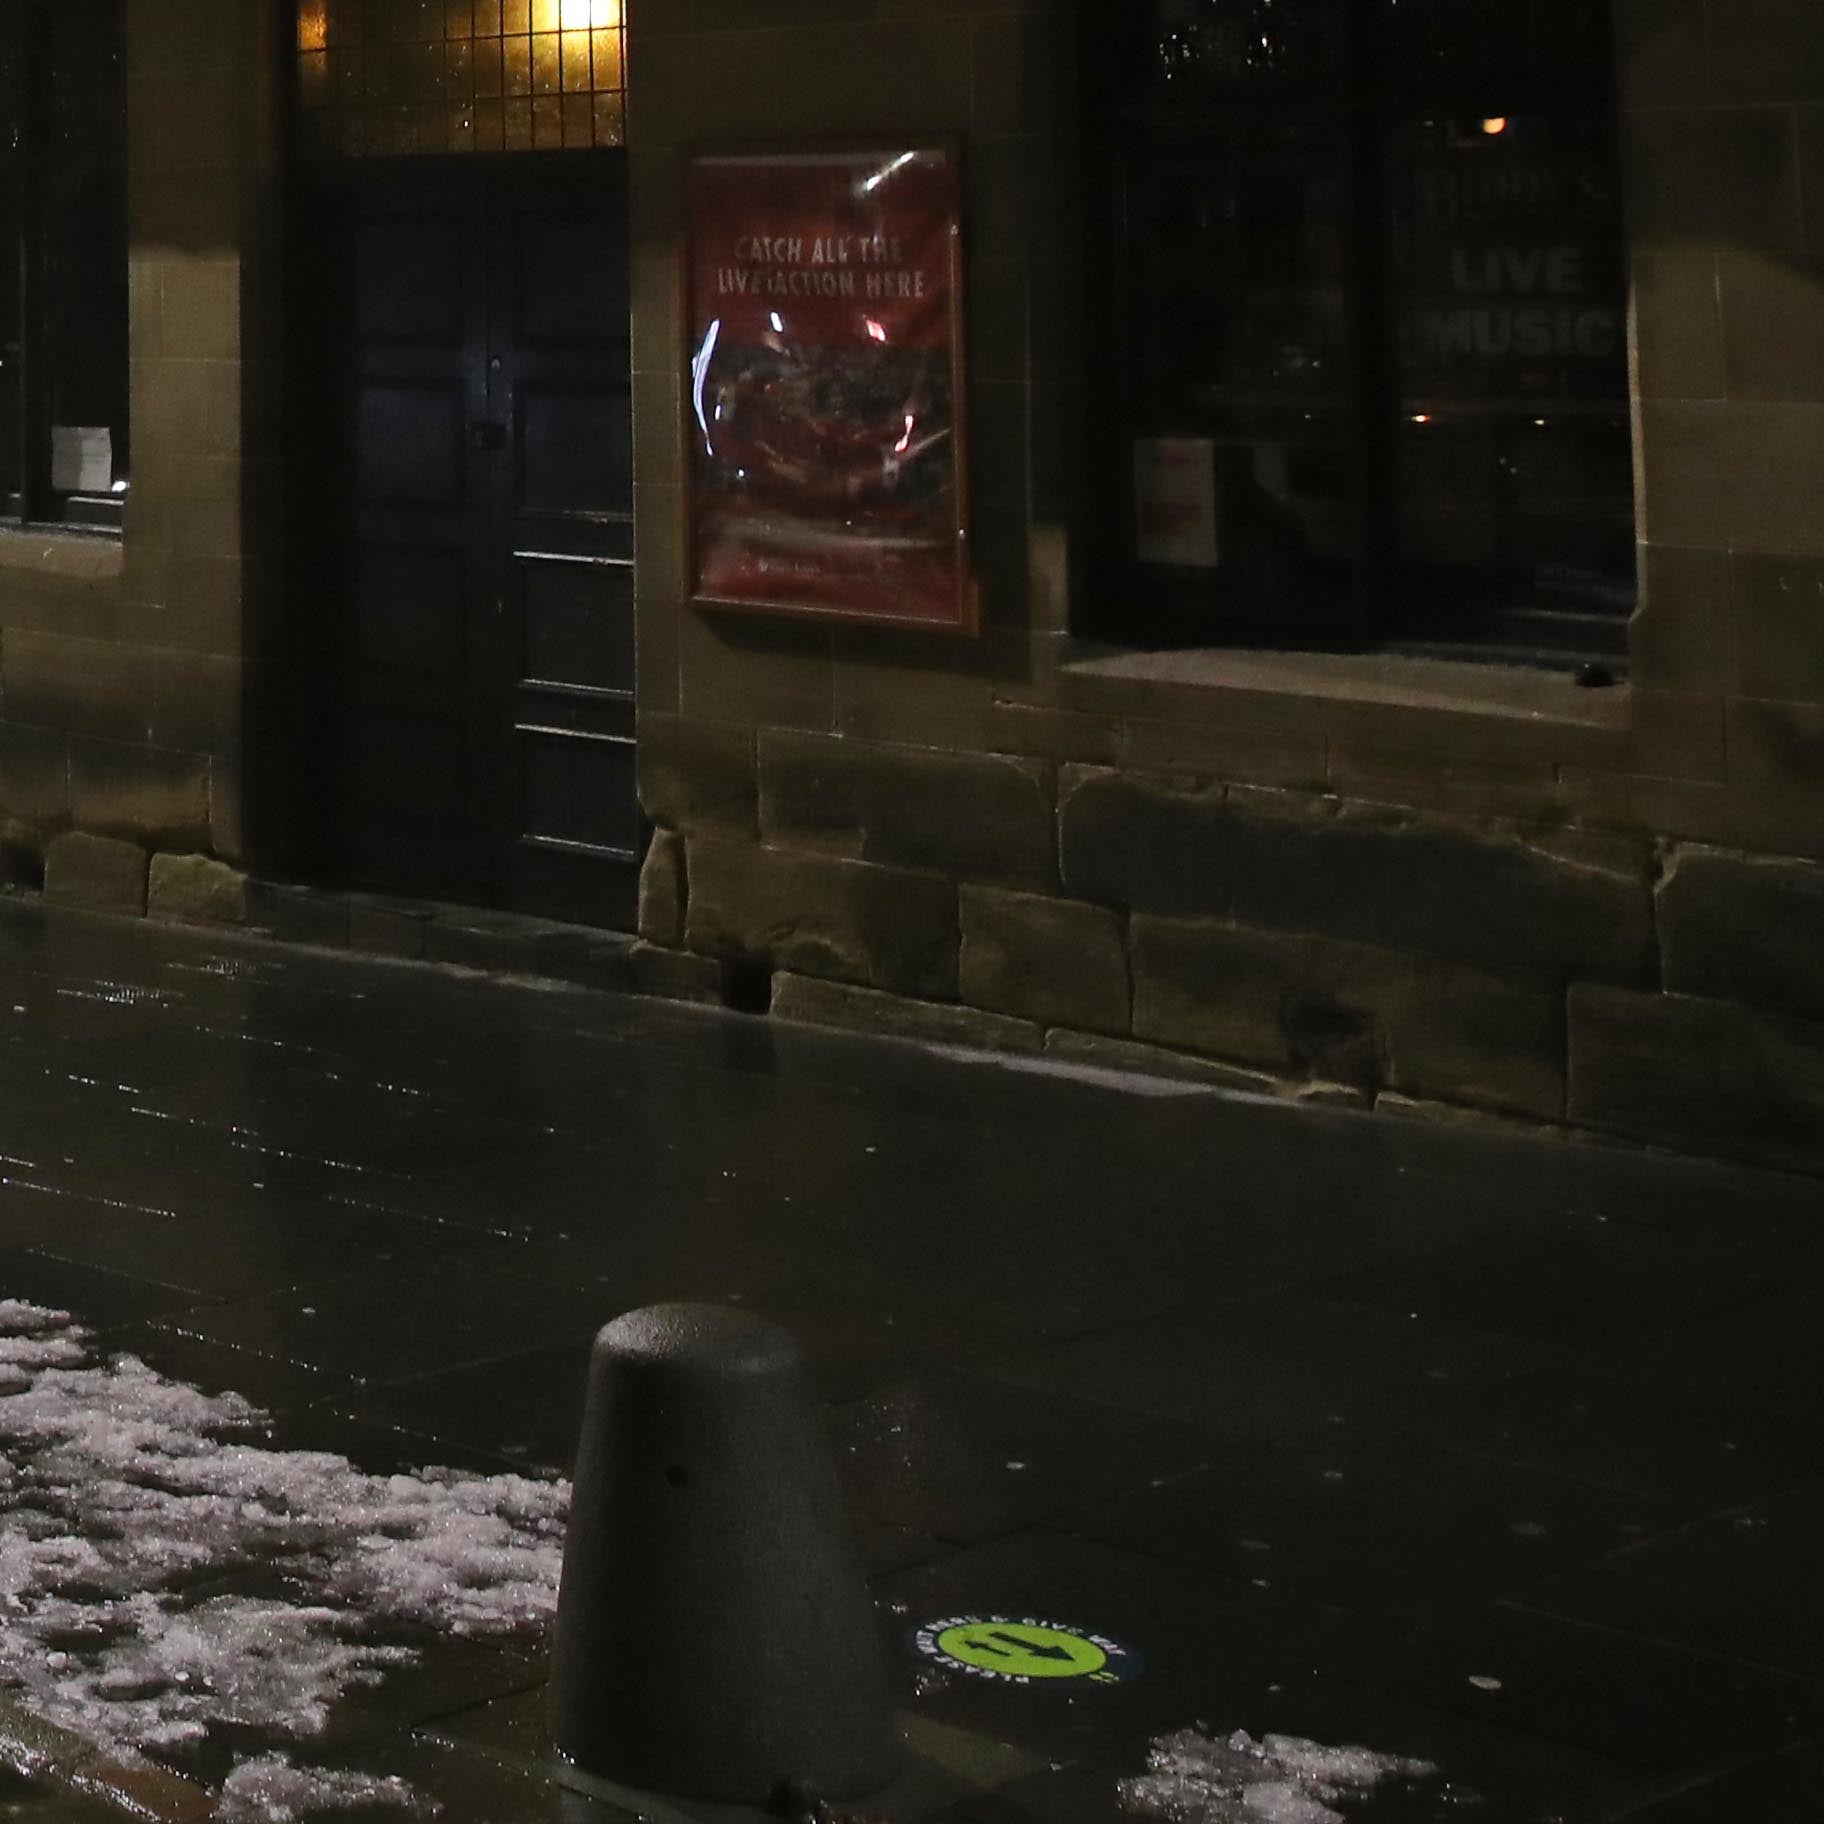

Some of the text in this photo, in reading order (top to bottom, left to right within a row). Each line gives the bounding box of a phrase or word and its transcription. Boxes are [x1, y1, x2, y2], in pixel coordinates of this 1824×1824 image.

[733, 236, 904, 264] CATCH ALL THE
[1451, 245, 1583, 293] LIVE
[717, 267, 925, 298] LIVE ACTION HERE
[1424, 307, 1616, 358] MUSIC
